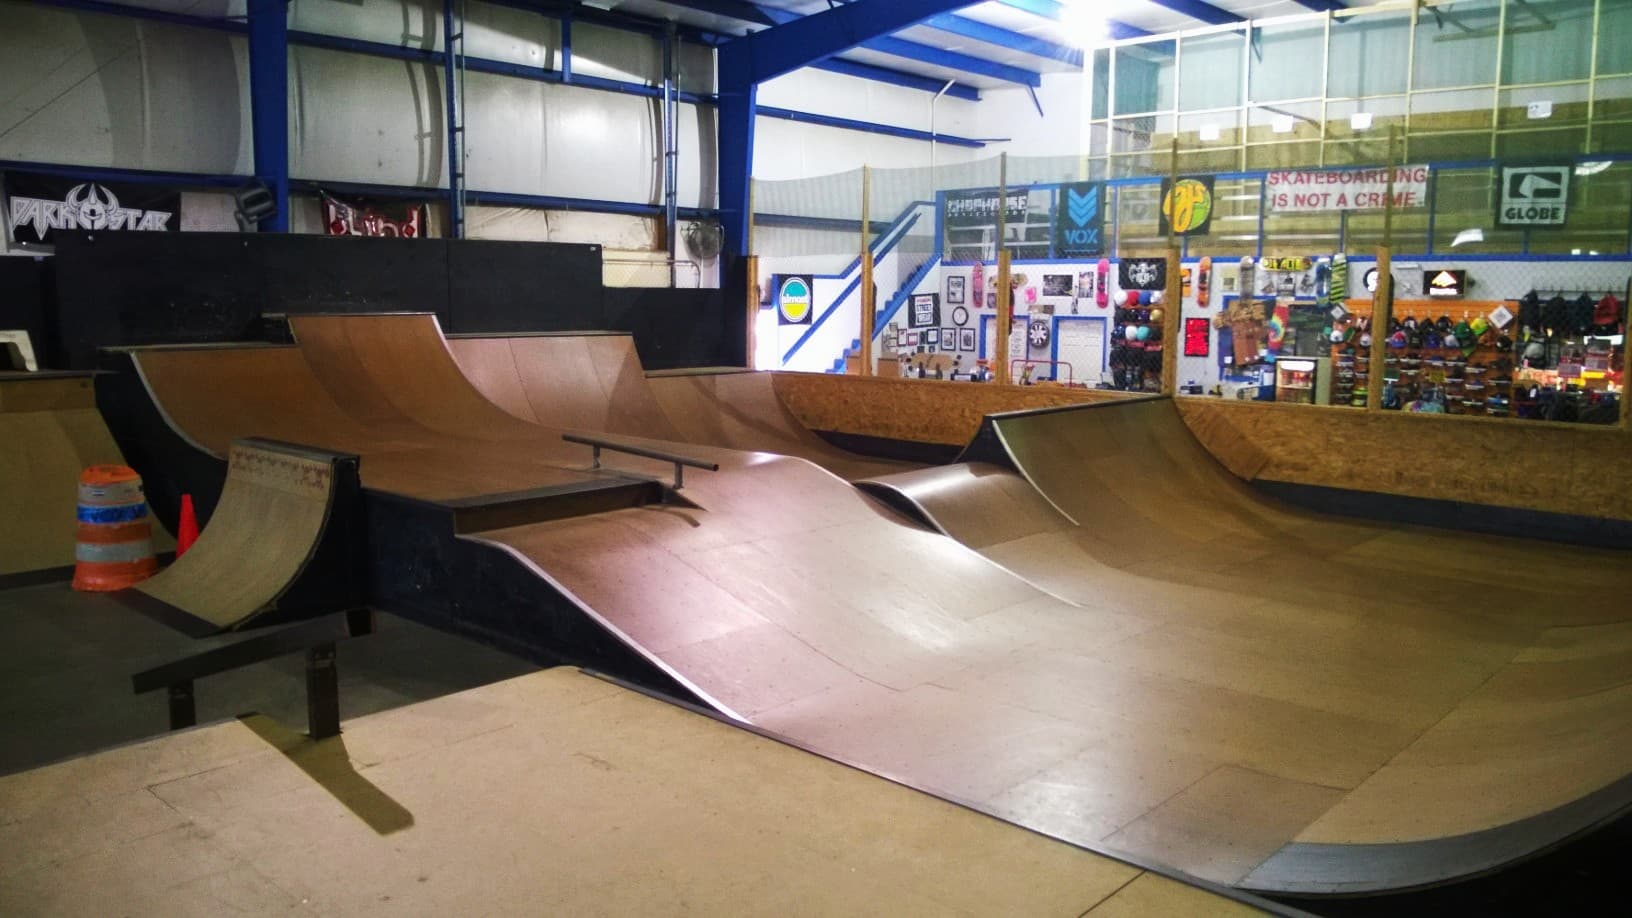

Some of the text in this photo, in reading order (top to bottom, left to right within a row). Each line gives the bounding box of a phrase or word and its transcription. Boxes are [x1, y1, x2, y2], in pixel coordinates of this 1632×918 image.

[1268, 167, 1426, 185] SKATEBOARDING
[1271, 193, 1288, 208] IS
[1293, 193, 1332, 208] NOT
[1336, 193, 1348, 207] A
[1505, 207, 1561, 220] GLOBE
[1064, 228, 1099, 245] VOX
